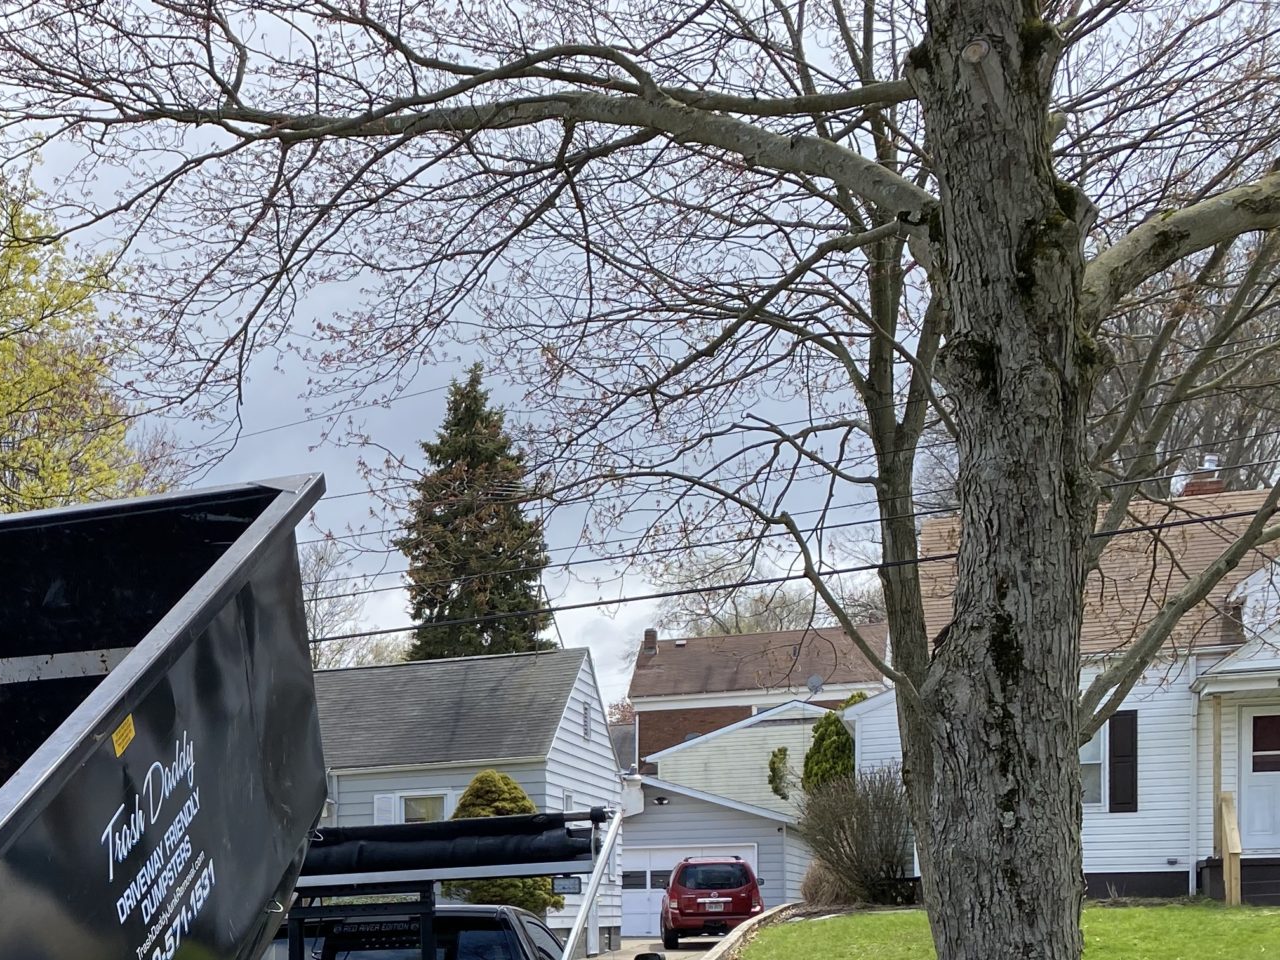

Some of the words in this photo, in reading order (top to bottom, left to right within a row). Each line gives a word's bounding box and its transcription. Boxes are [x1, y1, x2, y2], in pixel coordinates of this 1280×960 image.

[101, 793, 146, 882] Trash
[142, 730, 195, 825] Daddy
[116, 840, 164, 925] DRIVEWAY
[163, 786, 200, 856] FRIENDLY
[135, 850, 205, 960] TrashDaddyJunkRemoval.com
[140, 834, 192, 925] DUMPSTERS
[359, 923, 380, 932] RIVER
[381, 922, 409, 931] EDITION
